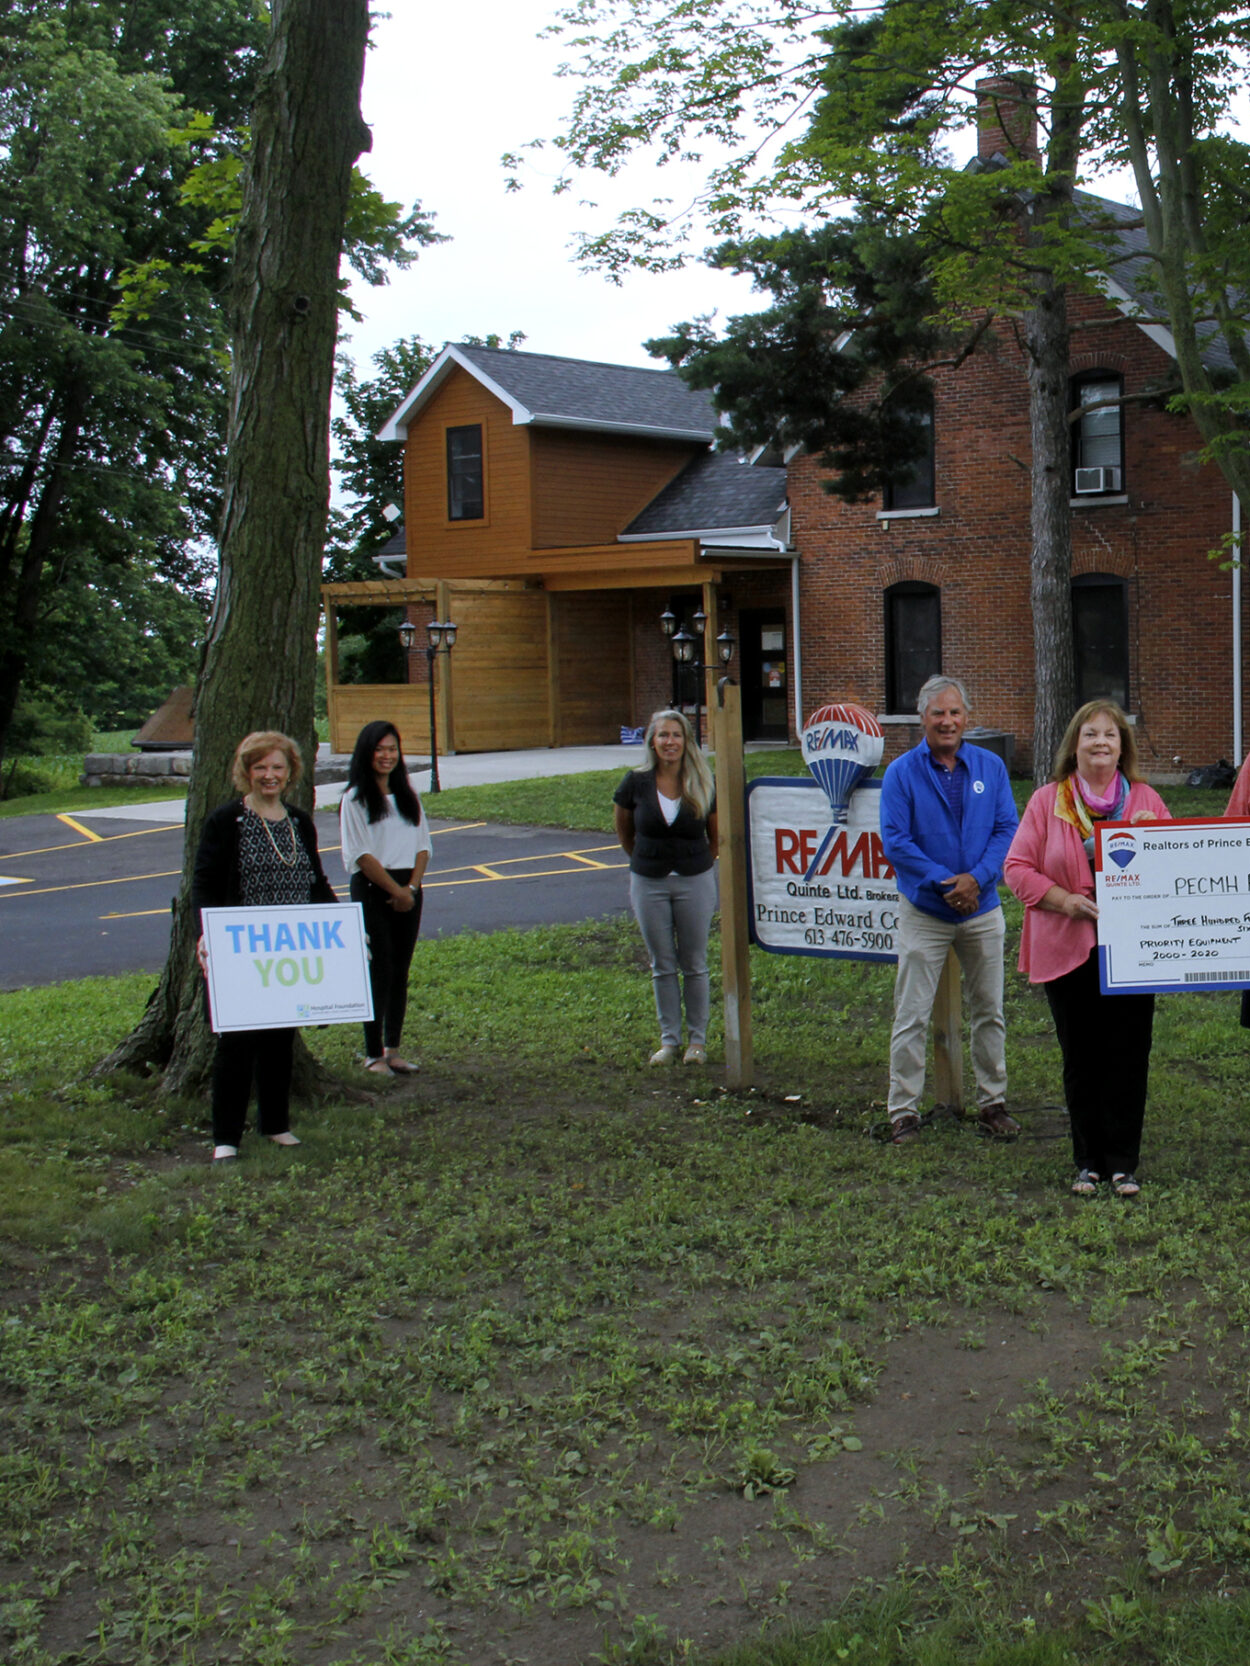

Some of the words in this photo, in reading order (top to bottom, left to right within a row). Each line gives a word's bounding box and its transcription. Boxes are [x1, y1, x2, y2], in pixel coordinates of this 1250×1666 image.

[806, 727, 860, 753] RE/MAX
[774, 825, 898, 882] RE/MA
[1109, 841, 1135, 849] RE/MAX
[1143, 841, 1190, 851] Realtors
[1192, 839, 1204, 849] of
[1207, 838, 1242, 848] Prince
[1105, 874, 1141, 882] RE/MAX
[1174, 874, 1239, 895] PECMH
[786, 881, 831, 898] Quinte
[837, 884, 863, 901] Ltd.
[756, 903, 807, 924] Prince
[814, 907, 874, 929] Edward
[1170, 914, 1197, 927] THREE
[1200, 914, 1241, 927] HUNDRED
[224, 920, 346, 954] THANK
[804, 928, 826, 945] 613
[831, 930, 893, 950] 476-5900
[1139, 939, 1185, 949] PRIORITY
[1188, 937, 1241, 947] EQUIPMENT
[253, 956, 325, 988] YOU
